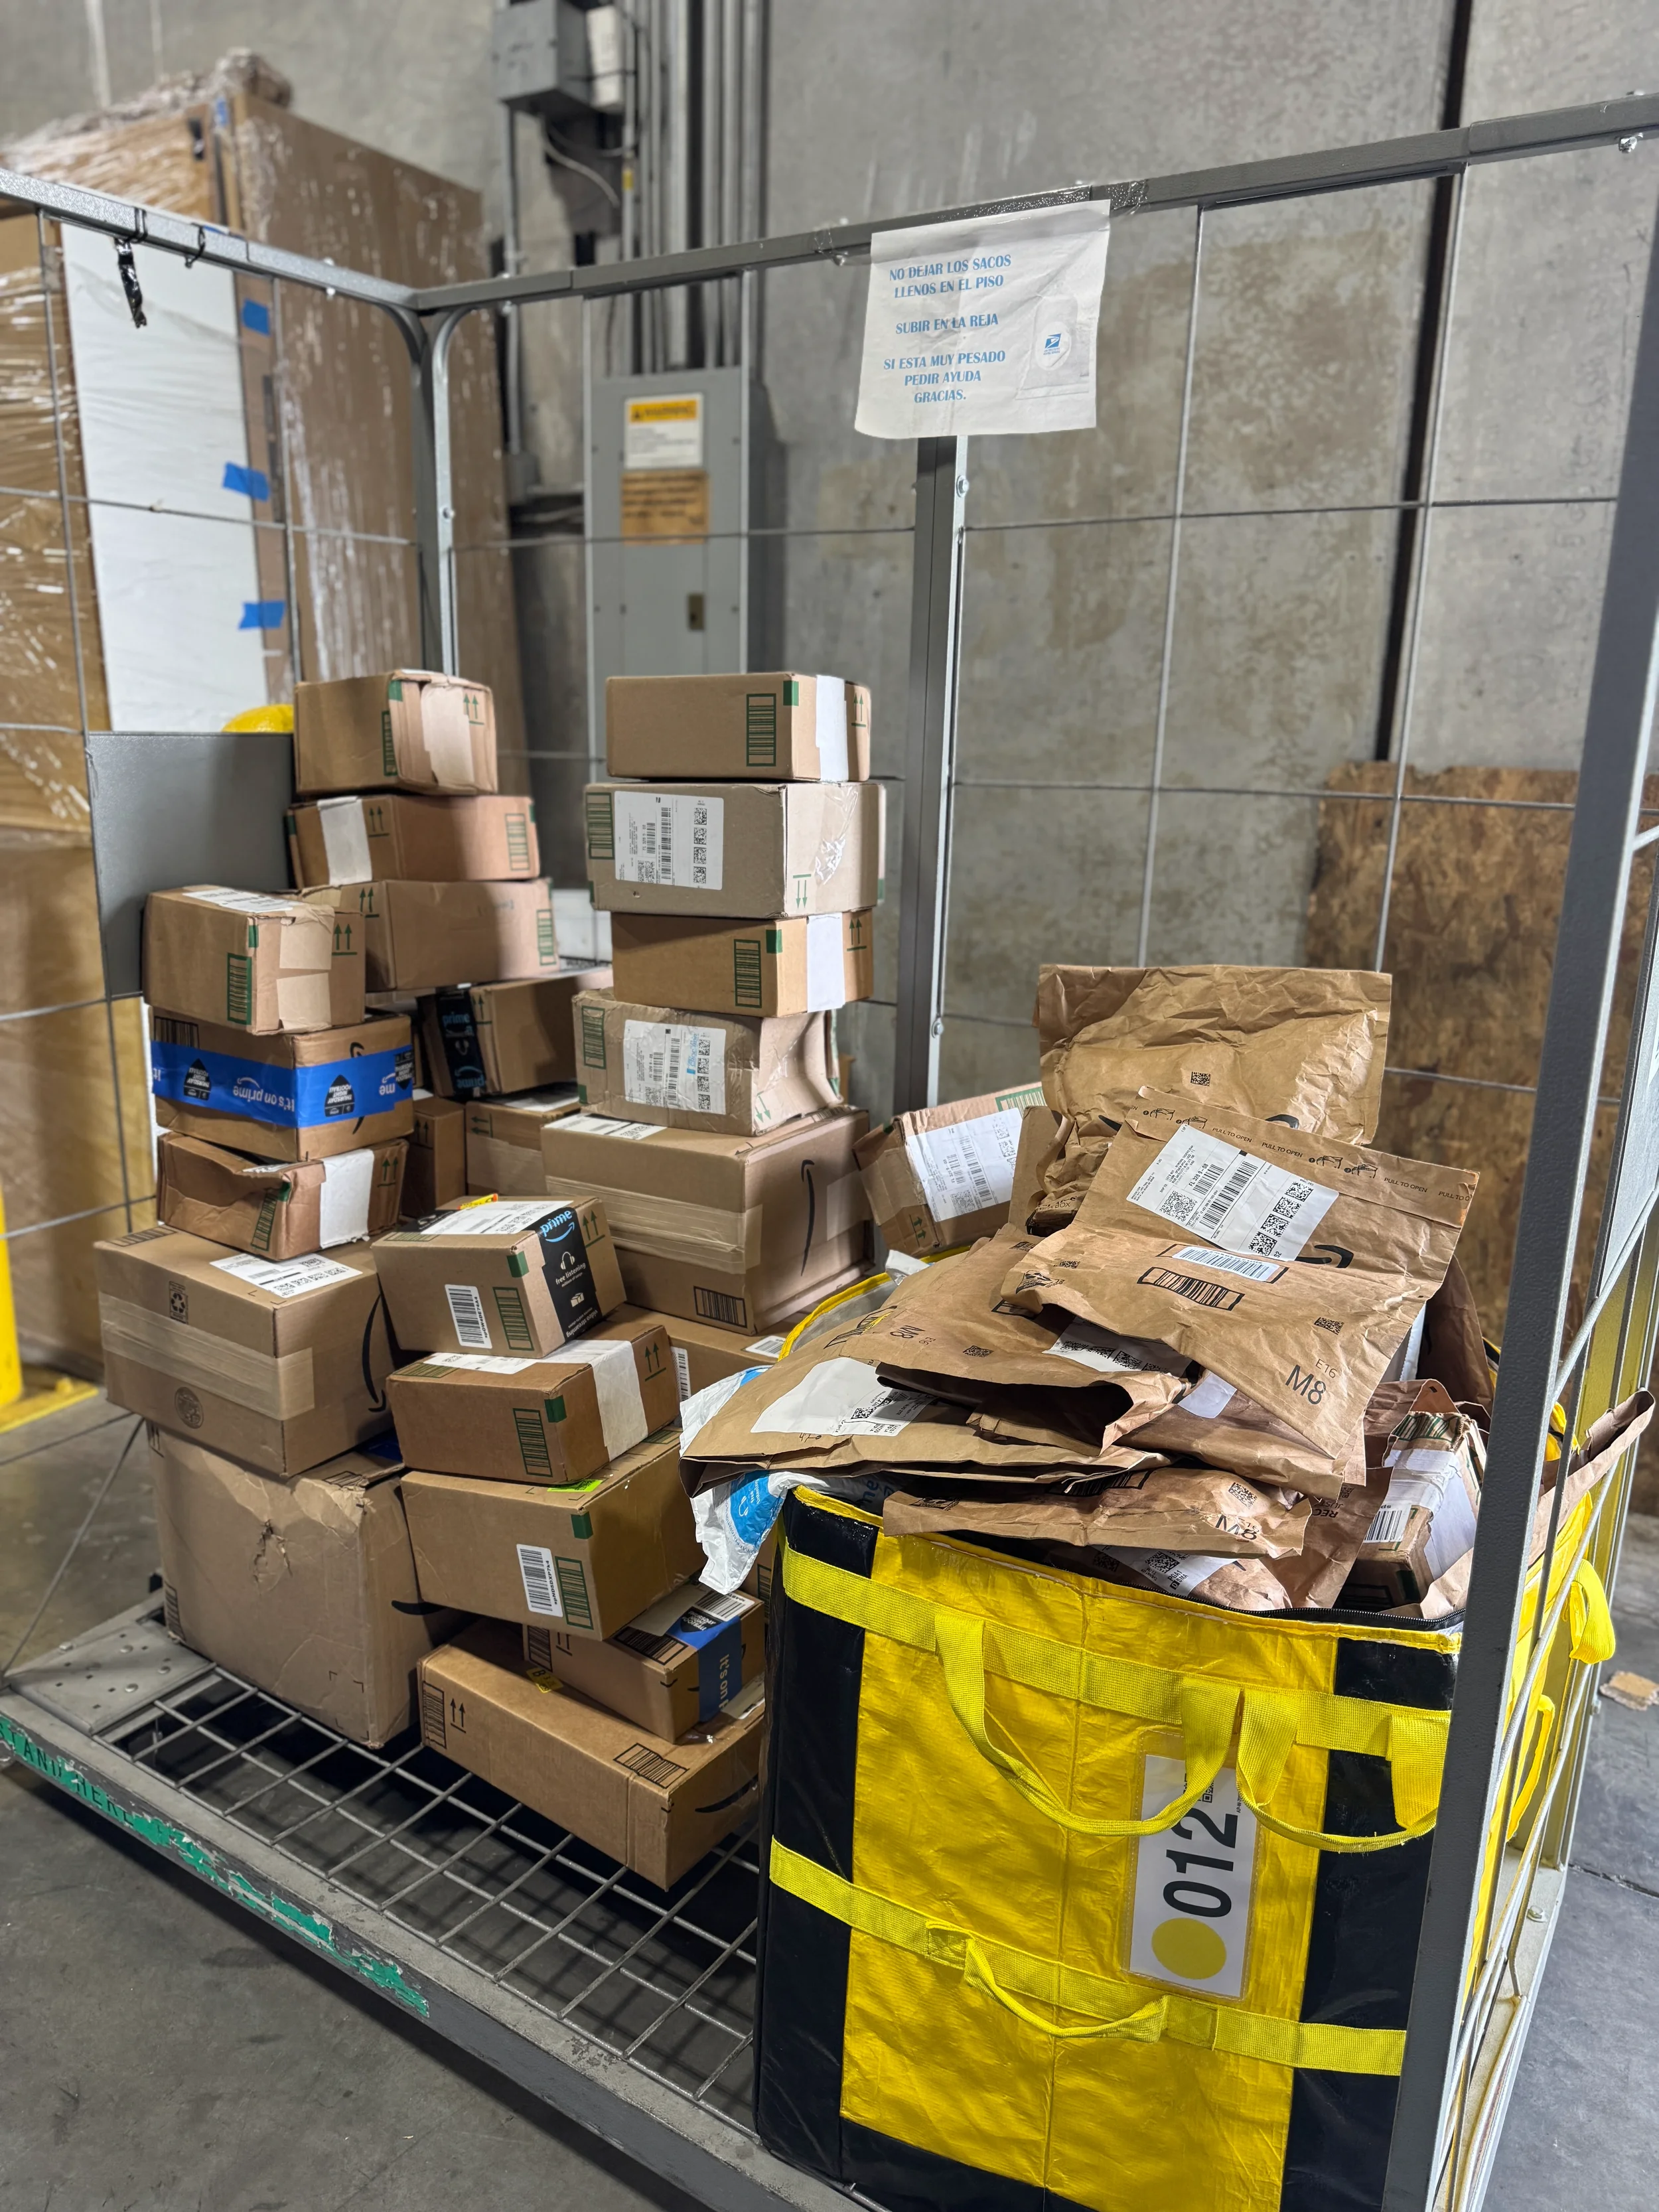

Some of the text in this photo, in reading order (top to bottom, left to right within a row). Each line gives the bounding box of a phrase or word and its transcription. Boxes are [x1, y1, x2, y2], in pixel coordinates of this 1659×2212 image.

[889, 254, 1012, 281] NO DEJAR LOS SACOS
[894, 275, 1004, 299] LLENOS EN EL PISO
[895, 313, 999, 335] SUBIR EN LA REJA
[883, 350, 1006, 370] SI ESTA MUY PESADO
[904, 370, 981, 387] PEDIR AYUDA
[914, 389, 967, 404] GRACIAS.
[442, 1011, 471, 1027] prime
[186, 1078, 210, 1088] THURSDAY
[328, 1084, 352, 1093] FOOTBALL
[232, 1086, 295, 1112] It's on prime
[327, 1094, 352, 1104] THURSDAY
[1212, 1127, 1227, 1136] PULL
[1236, 1134, 1252, 1143] OPEN
[1262, 1142, 1276, 1151] PULL
[1285, 1147, 1303, 1158] OPEN
[1410, 1184, 1428, 1193] OPEN
[540, 1210, 573, 1237] prime
[1275, 1250, 1282, 1259] S2
[555, 1262, 586, 1285] free listening
[566, 1309, 599, 1337] video streaming
[890, 1325, 926, 1339] M8
[918, 1337, 936, 1345] E16
[1315, 1359, 1338, 1378] E16
[1285, 1364, 1327, 1405] M8
[1167, 1570, 1183, 1582] PGA1
[719, 1654, 729, 1679] It's
[719, 1681, 729, 1700] on
[1163, 1806, 1238, 1918] 012
